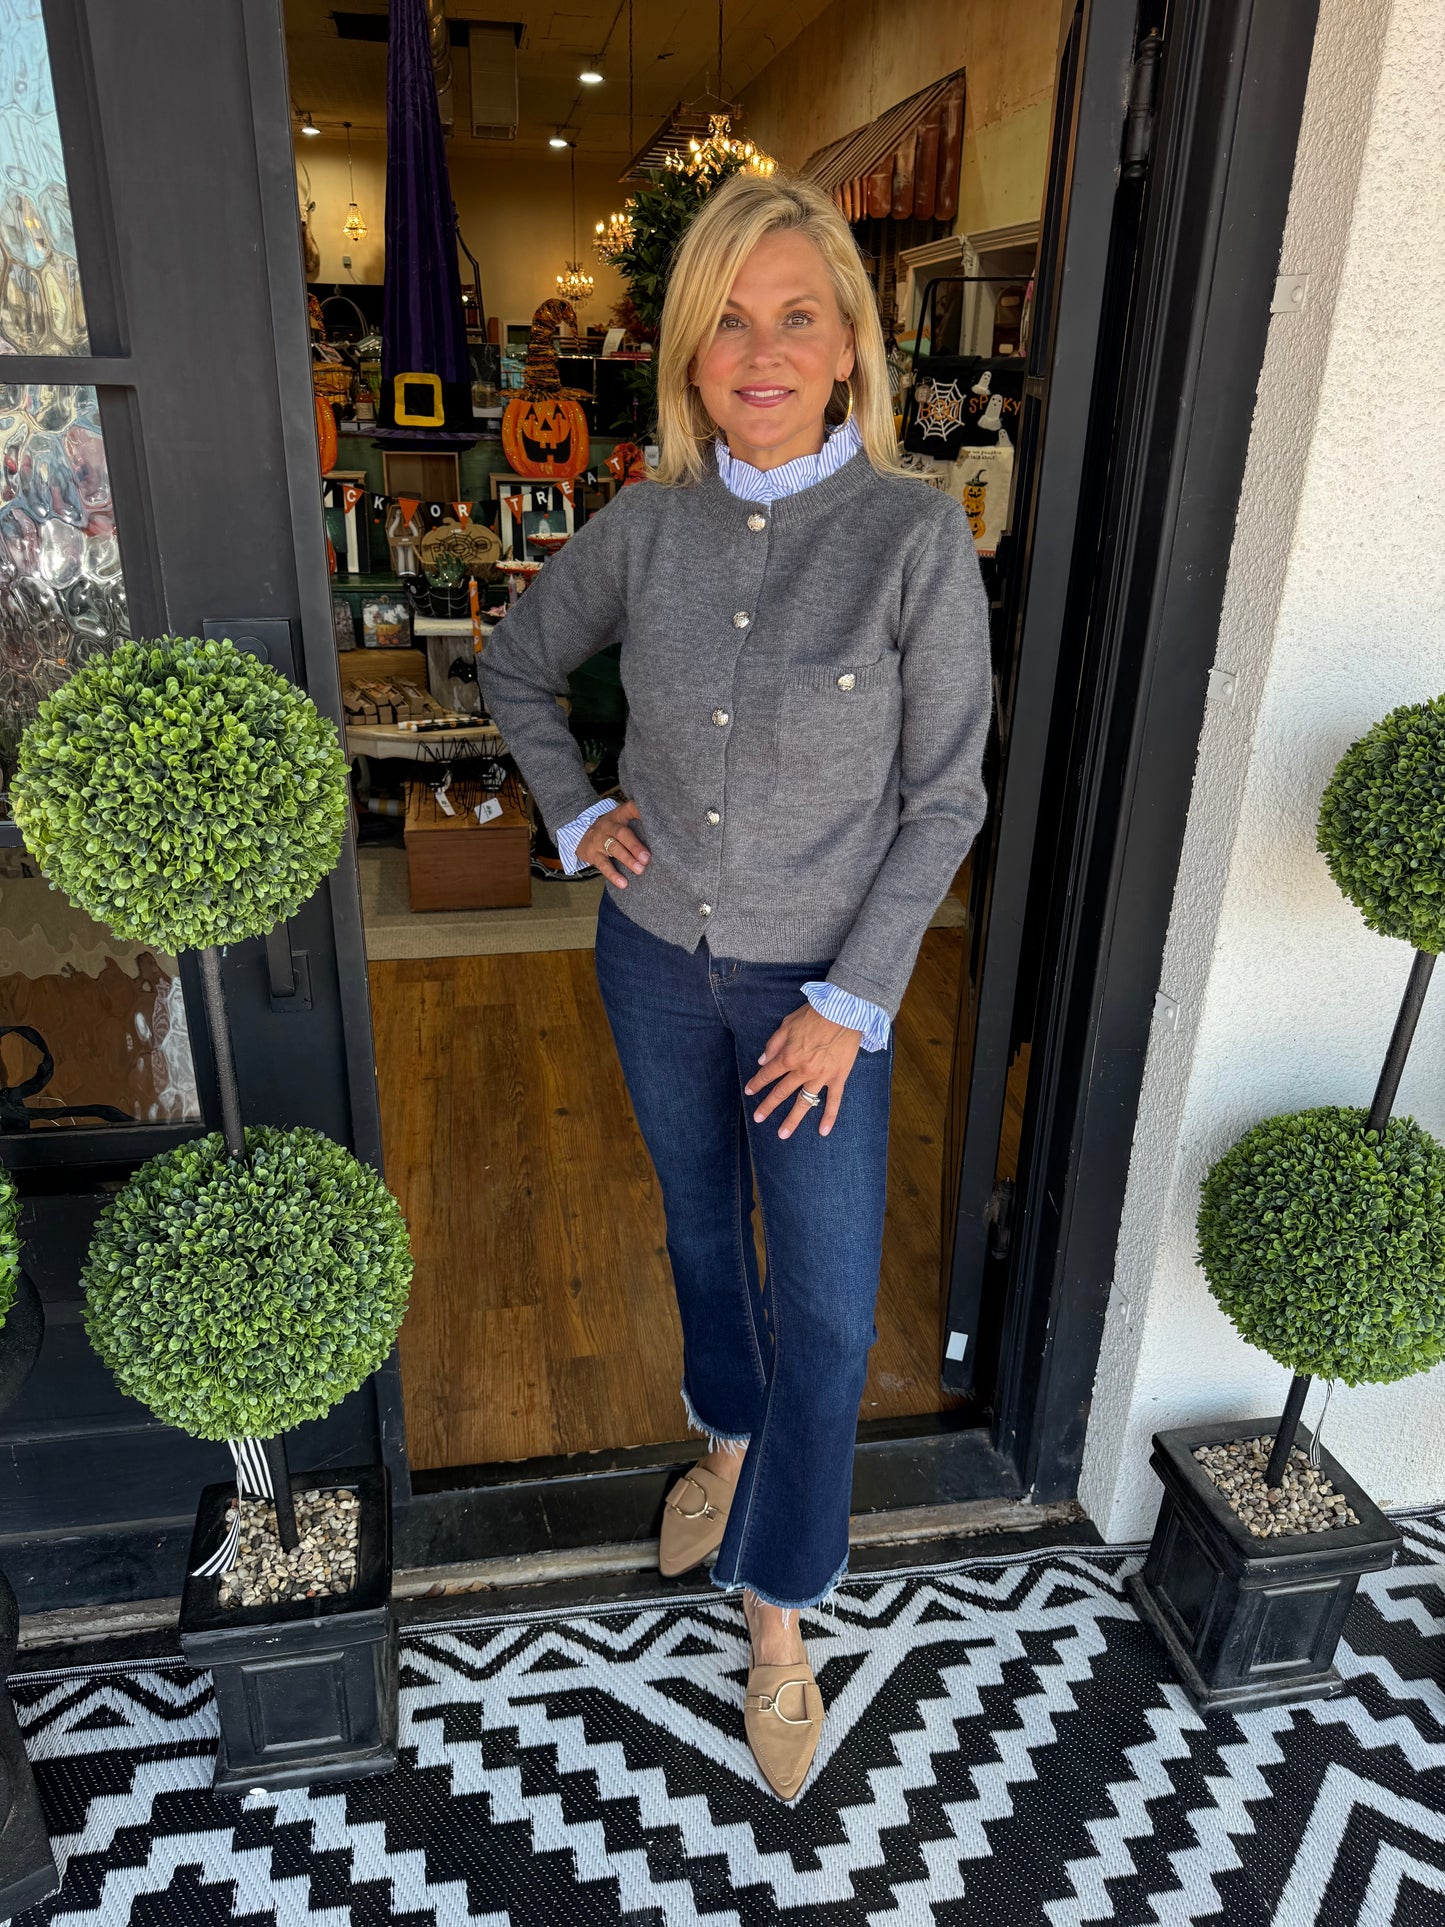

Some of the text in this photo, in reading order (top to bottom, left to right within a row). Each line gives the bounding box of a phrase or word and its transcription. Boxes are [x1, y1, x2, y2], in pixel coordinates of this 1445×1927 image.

[920, 399, 959, 422] BOO
[430, 504, 469, 517] OR
[510, 457, 621, 511] TREAT
